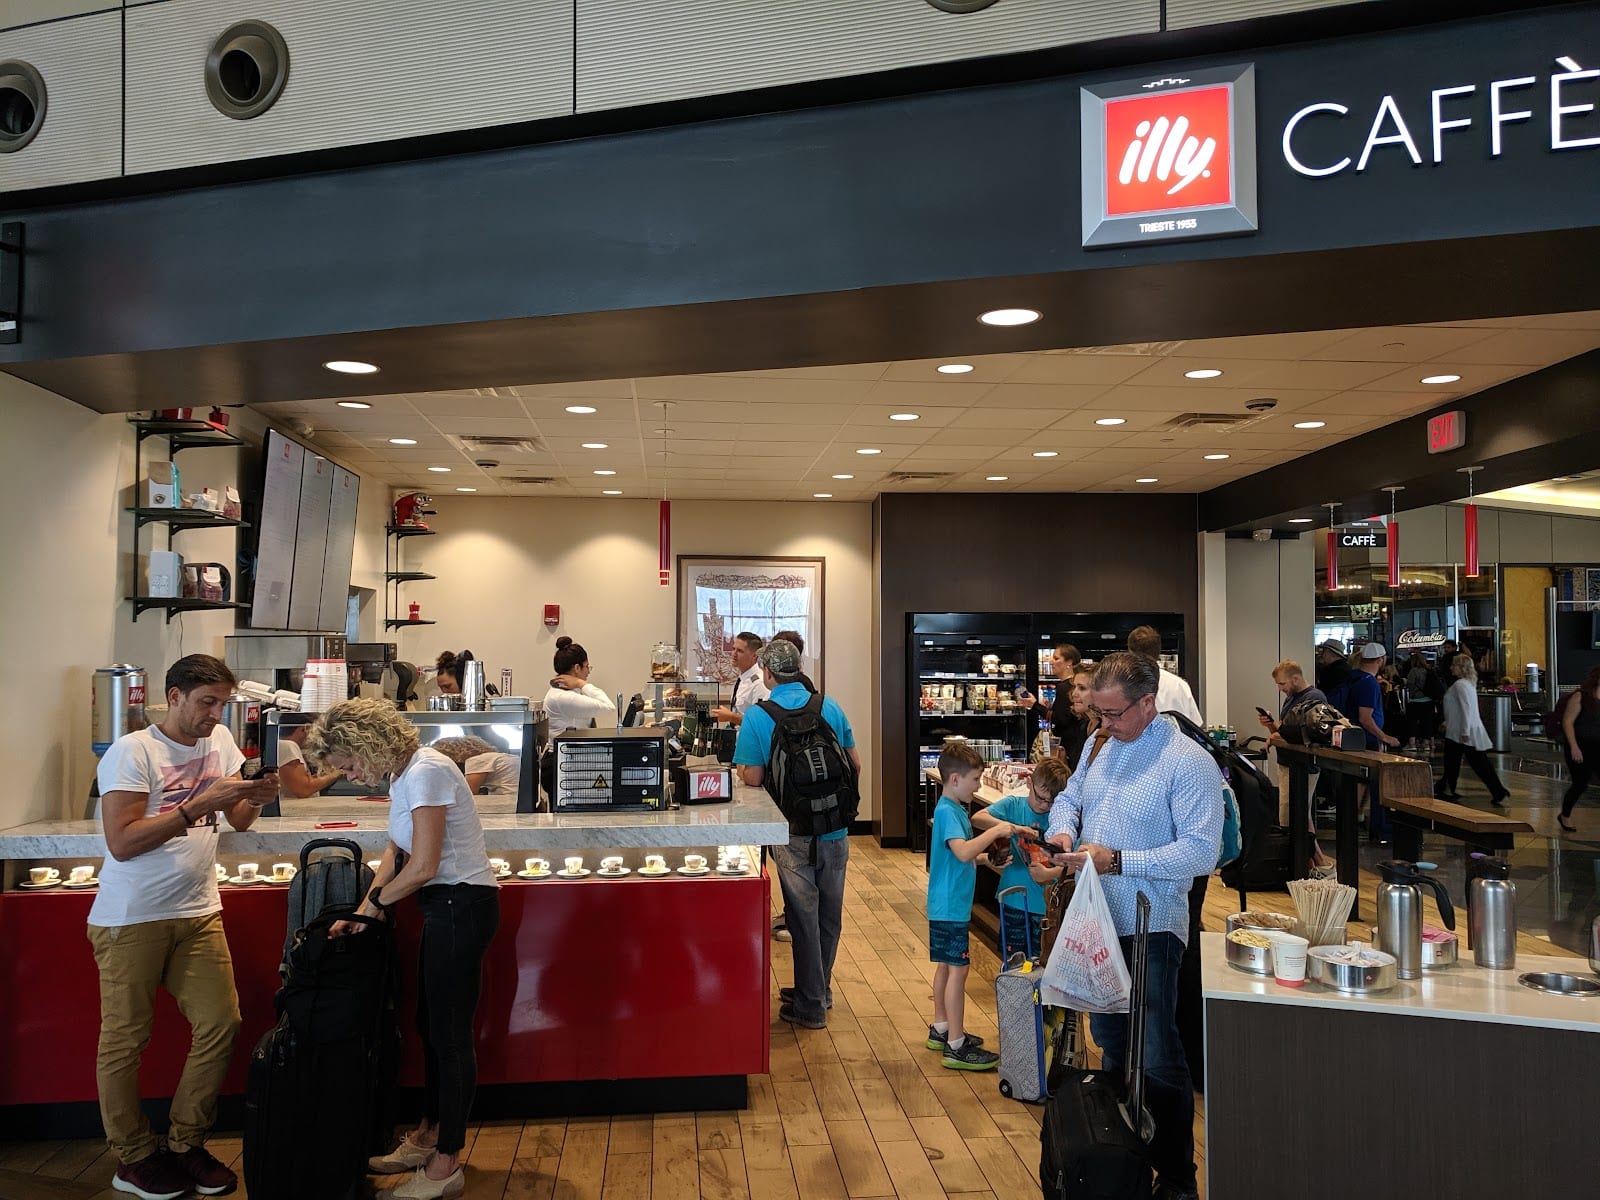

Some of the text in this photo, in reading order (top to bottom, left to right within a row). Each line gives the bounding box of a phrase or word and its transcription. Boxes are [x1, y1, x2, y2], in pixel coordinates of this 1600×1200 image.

[1282, 56, 1600, 177] CAFFÈ
[1139, 220, 1175, 233] TRIESTE
[1431, 413, 1454, 449] EXIT
[1342, 534, 1377, 546] CAFFÈ
[1398, 630, 1446, 644] Columbia
[130, 689, 145, 703] illy
[248, 708, 259, 720] illy
[699, 776, 720, 795] illy
